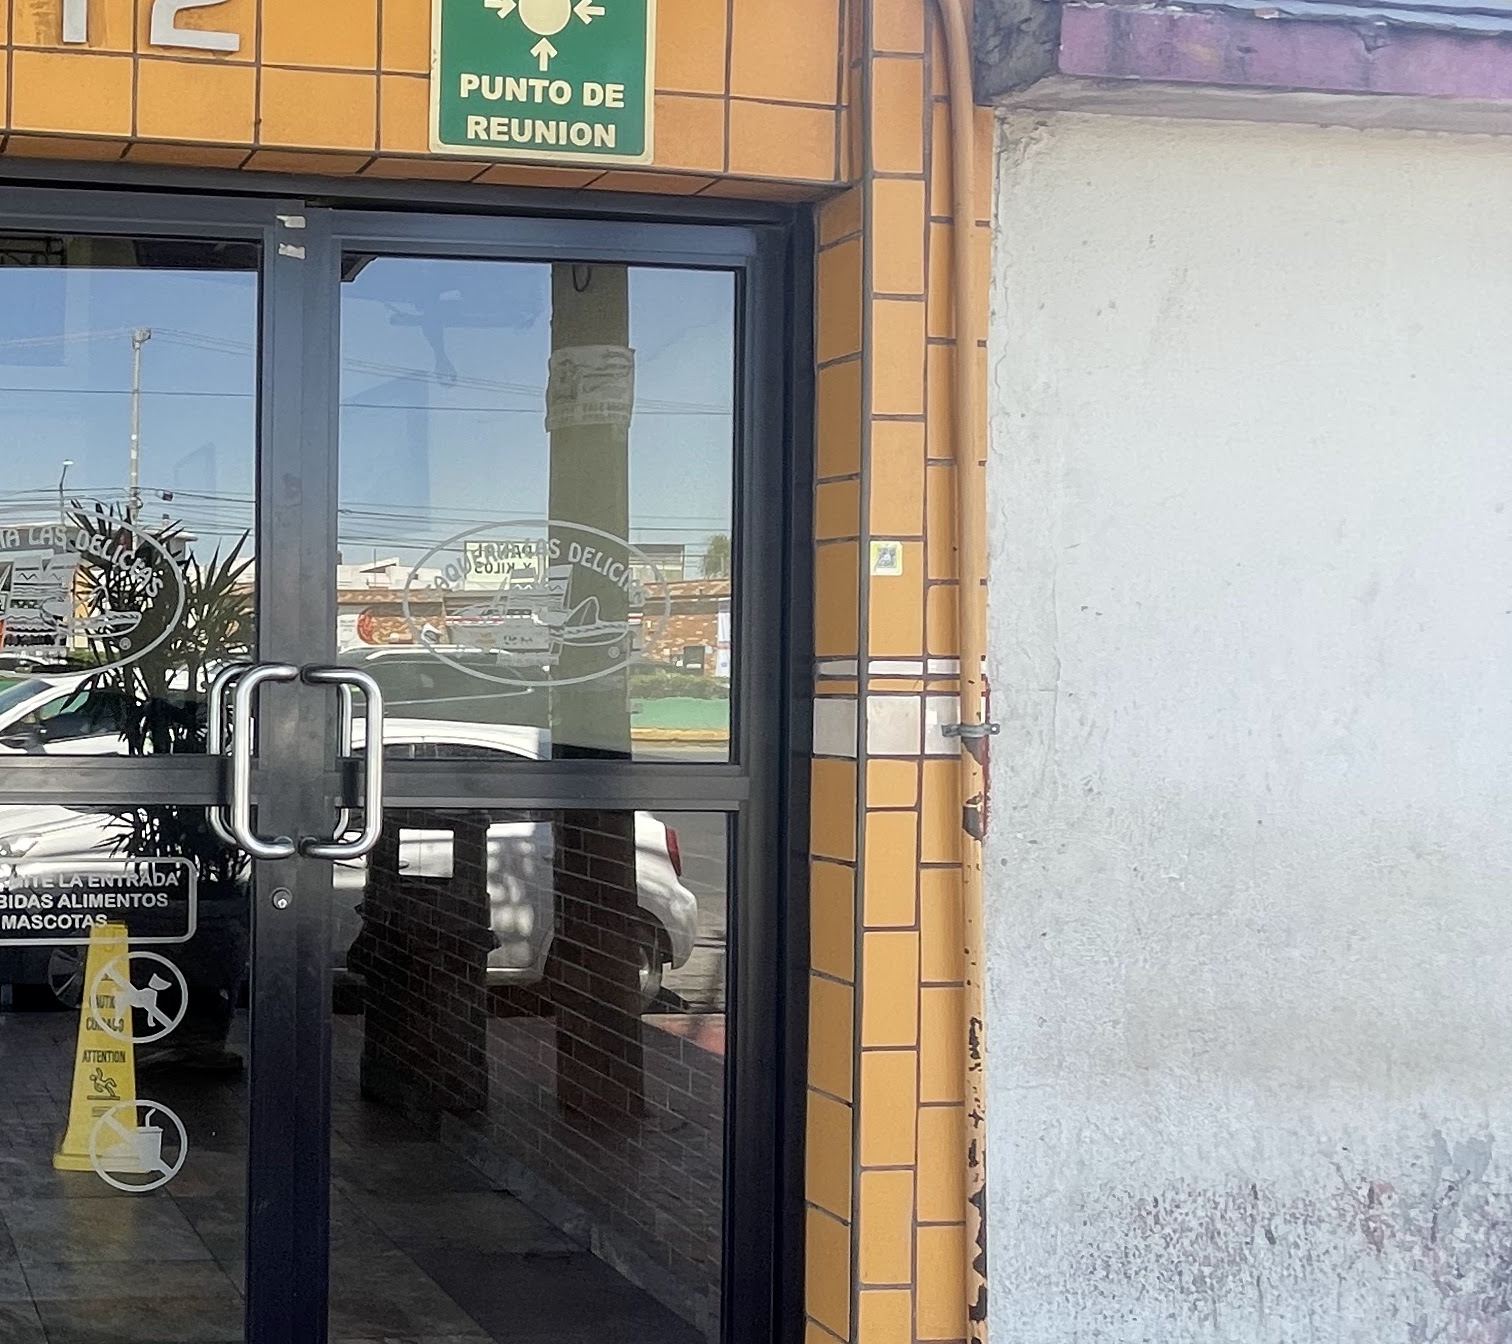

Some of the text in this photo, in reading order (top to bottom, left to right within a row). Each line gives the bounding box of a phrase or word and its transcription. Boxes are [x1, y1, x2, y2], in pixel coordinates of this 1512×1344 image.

[460, 72, 625, 108] PUNTO DE
[466, 113, 617, 149] REUNION
[28, 526, 67, 549] LAS
[59, 873, 84, 887] LA
[88, 871, 179, 888] ENTRADA
[57, 892, 168, 909] ALIMENTOS
[1, 913, 108, 930] MASCOTAS
[82, 1049, 126, 1063] ATTENTION
